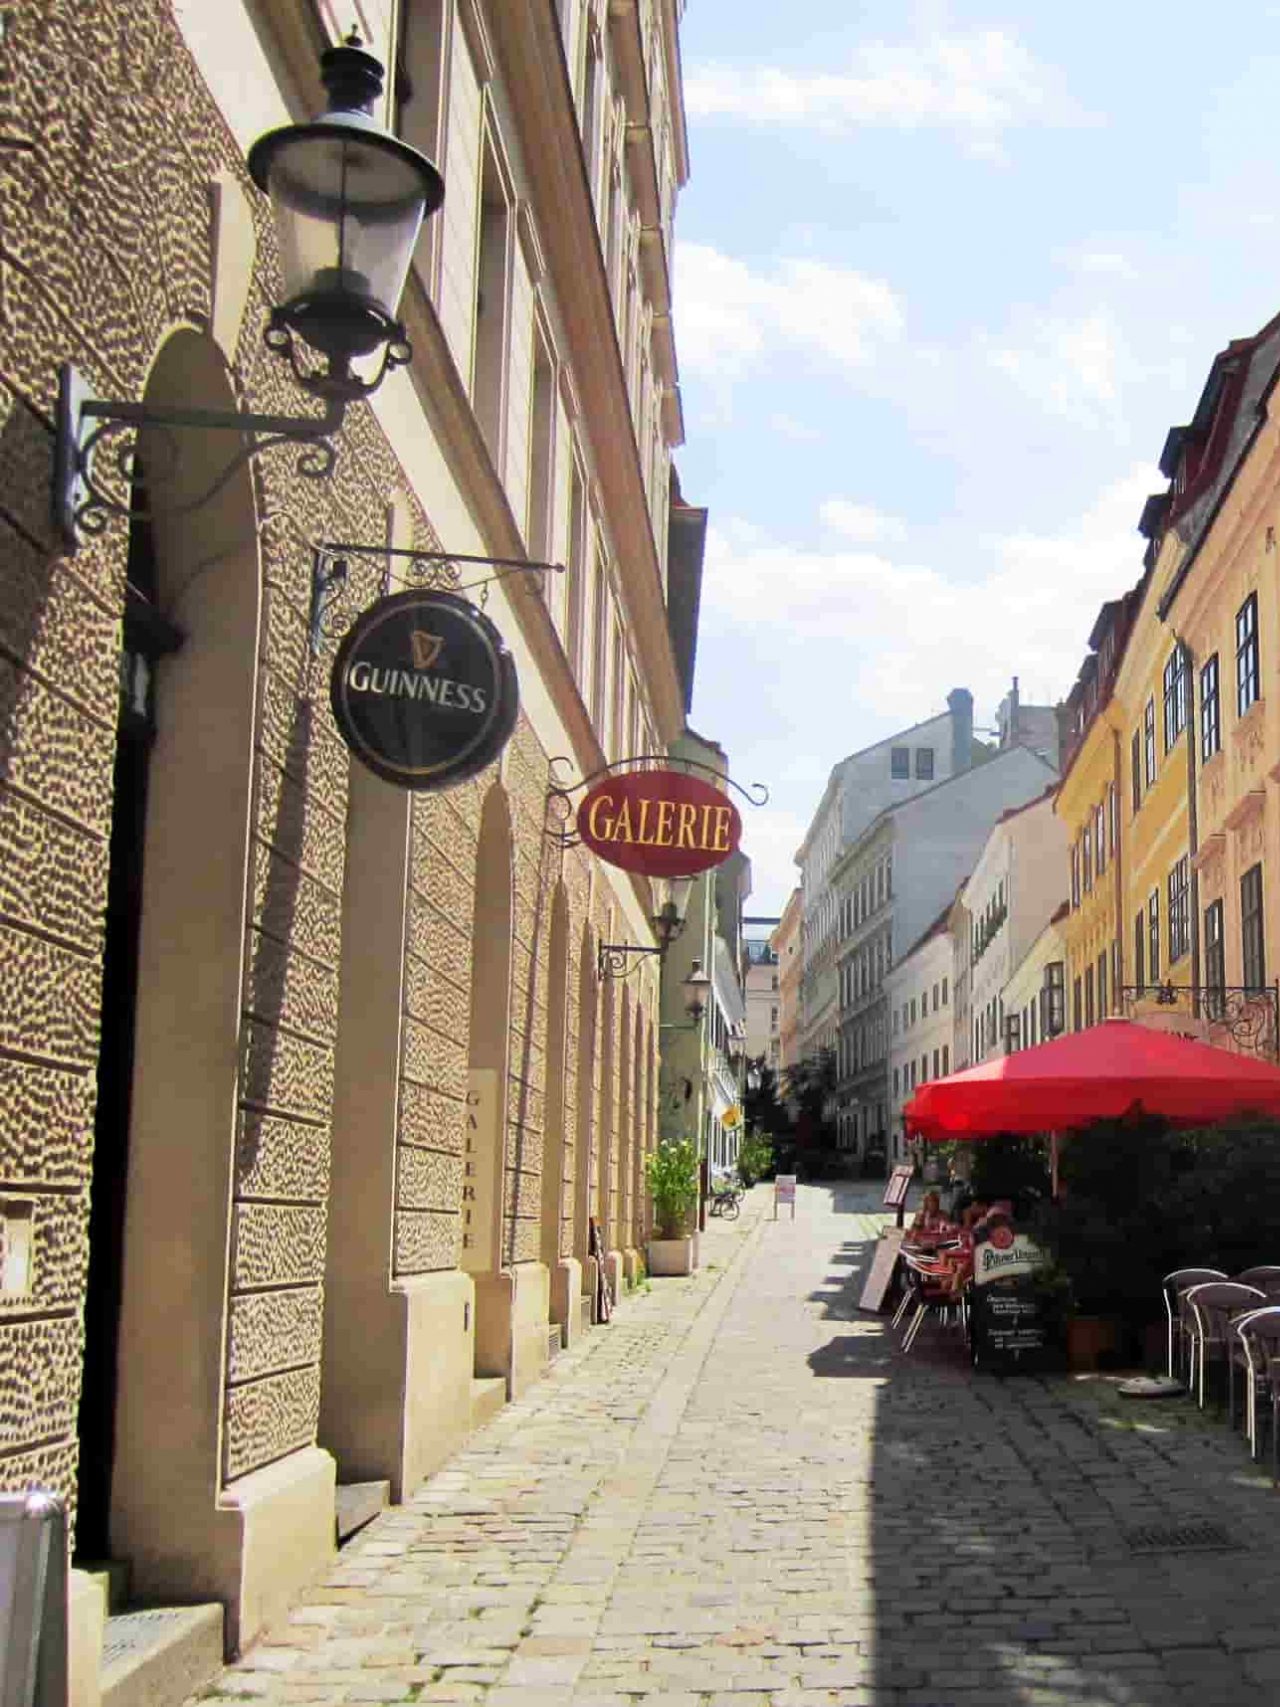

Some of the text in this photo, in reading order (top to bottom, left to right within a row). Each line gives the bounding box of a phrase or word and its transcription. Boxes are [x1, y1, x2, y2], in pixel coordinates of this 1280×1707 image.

[349, 661, 486, 713] GUINNESS
[588, 795, 732, 852] GALERIE
[462, 1090, 480, 1249] GALERIE
